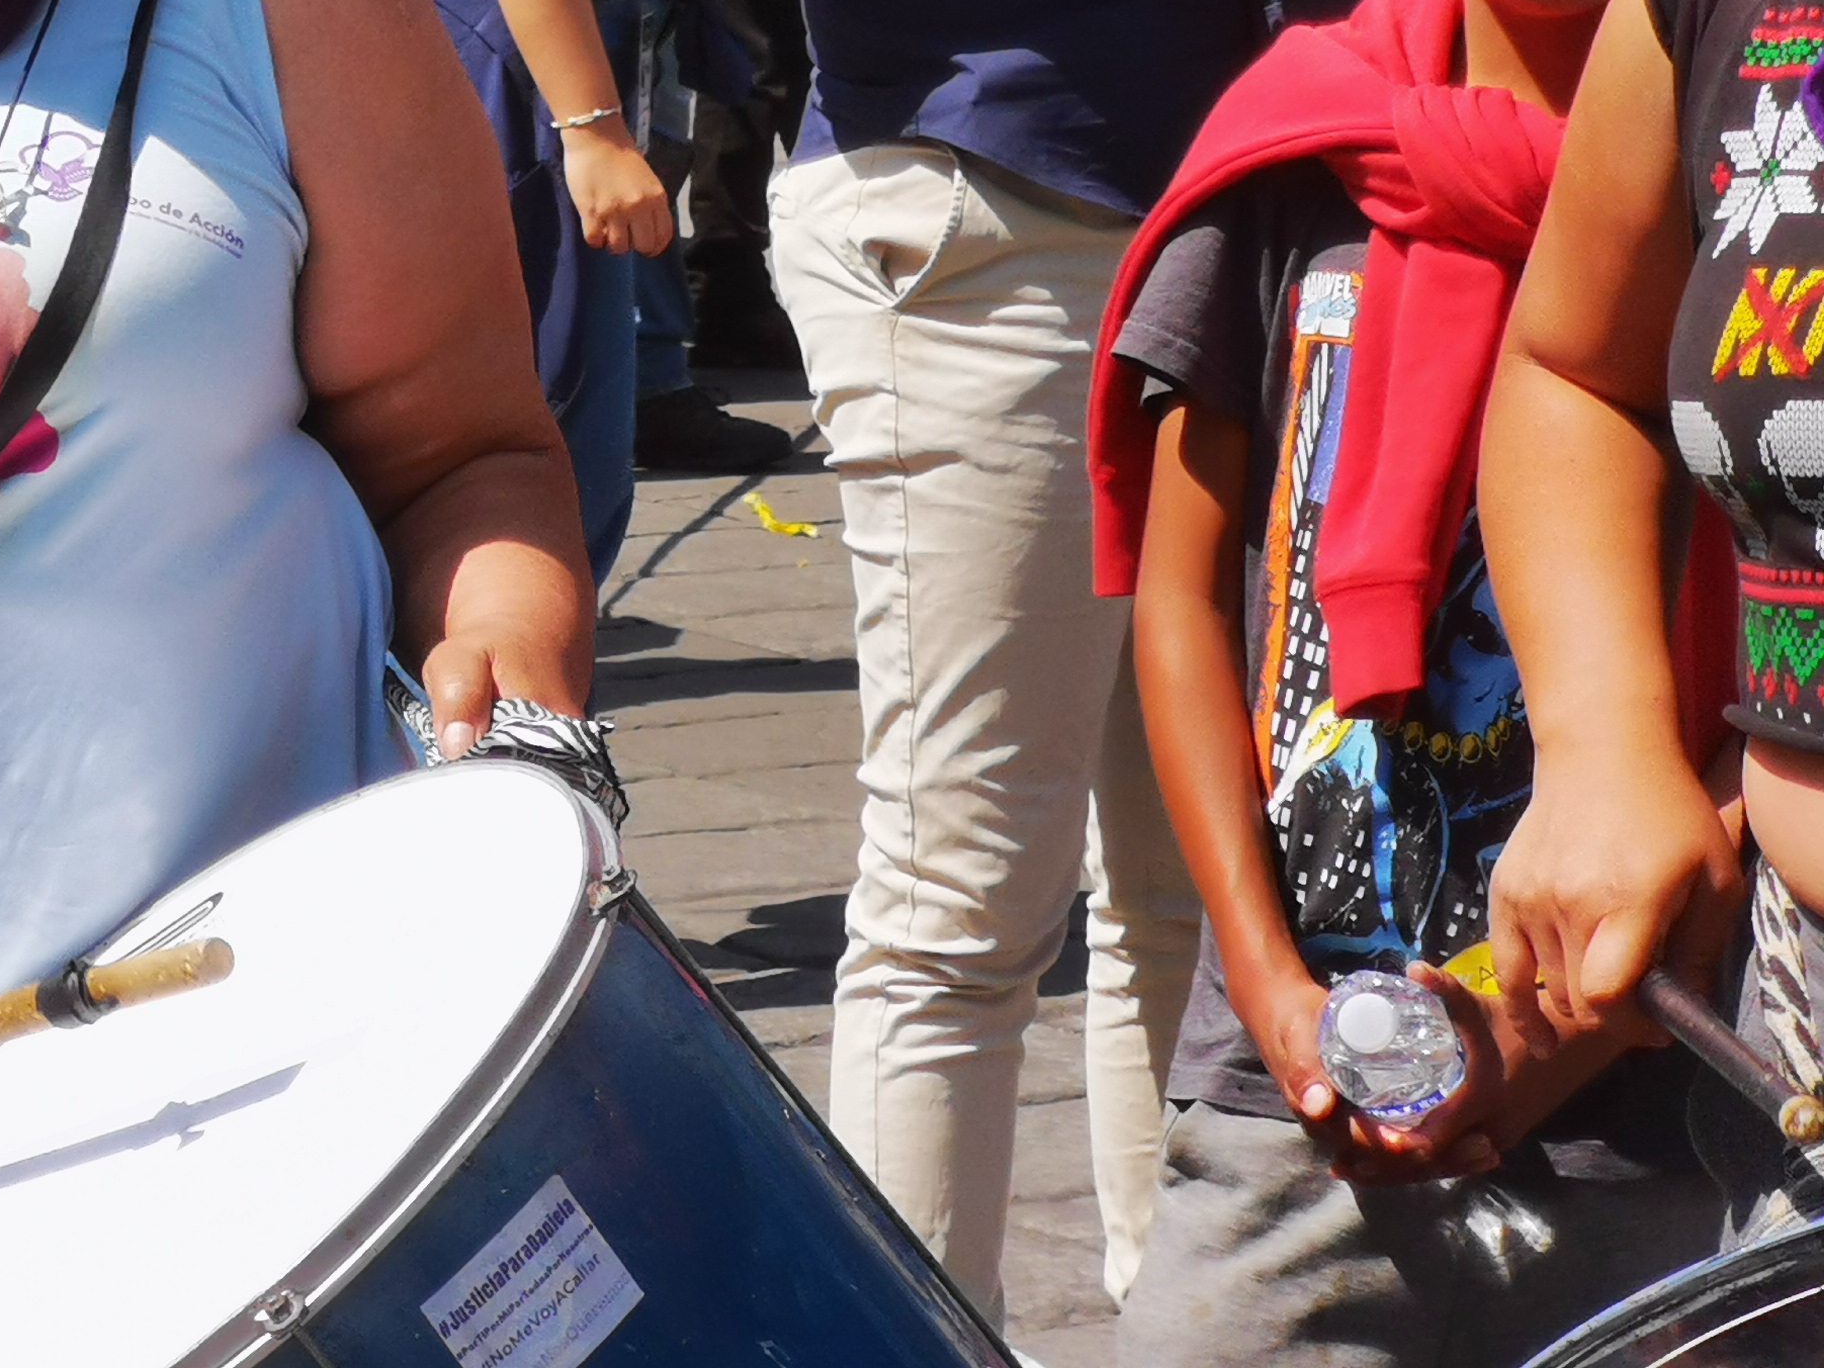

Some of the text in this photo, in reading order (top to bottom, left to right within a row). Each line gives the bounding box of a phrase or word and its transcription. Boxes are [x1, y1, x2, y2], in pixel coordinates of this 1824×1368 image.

[158, 201, 184, 220] de
[188, 211, 246, 251] Acción
[437, 1196, 577, 1340] #JusticiaParaDaniela
